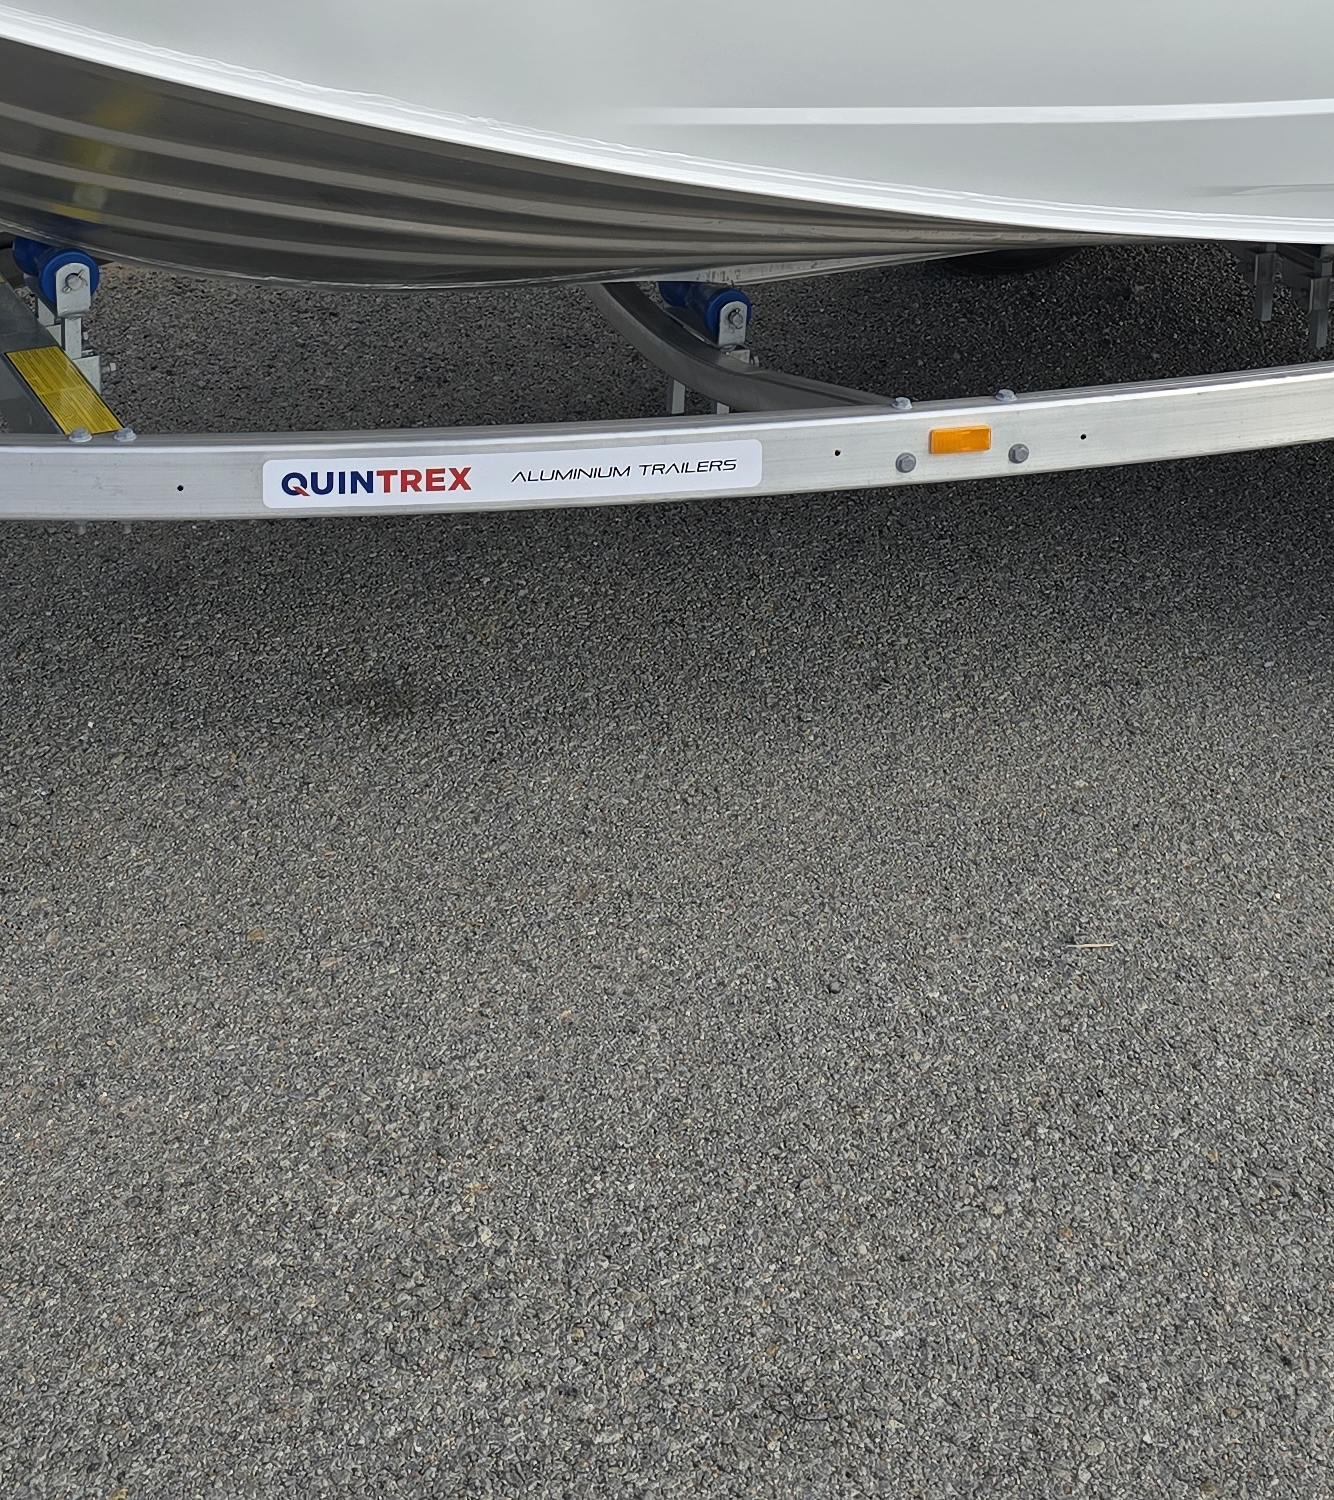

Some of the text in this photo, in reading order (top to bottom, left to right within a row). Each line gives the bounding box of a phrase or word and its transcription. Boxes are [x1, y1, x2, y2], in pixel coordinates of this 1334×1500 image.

[281, 458, 738, 497] QUINTREX ALUMINIUM TRAILERS
